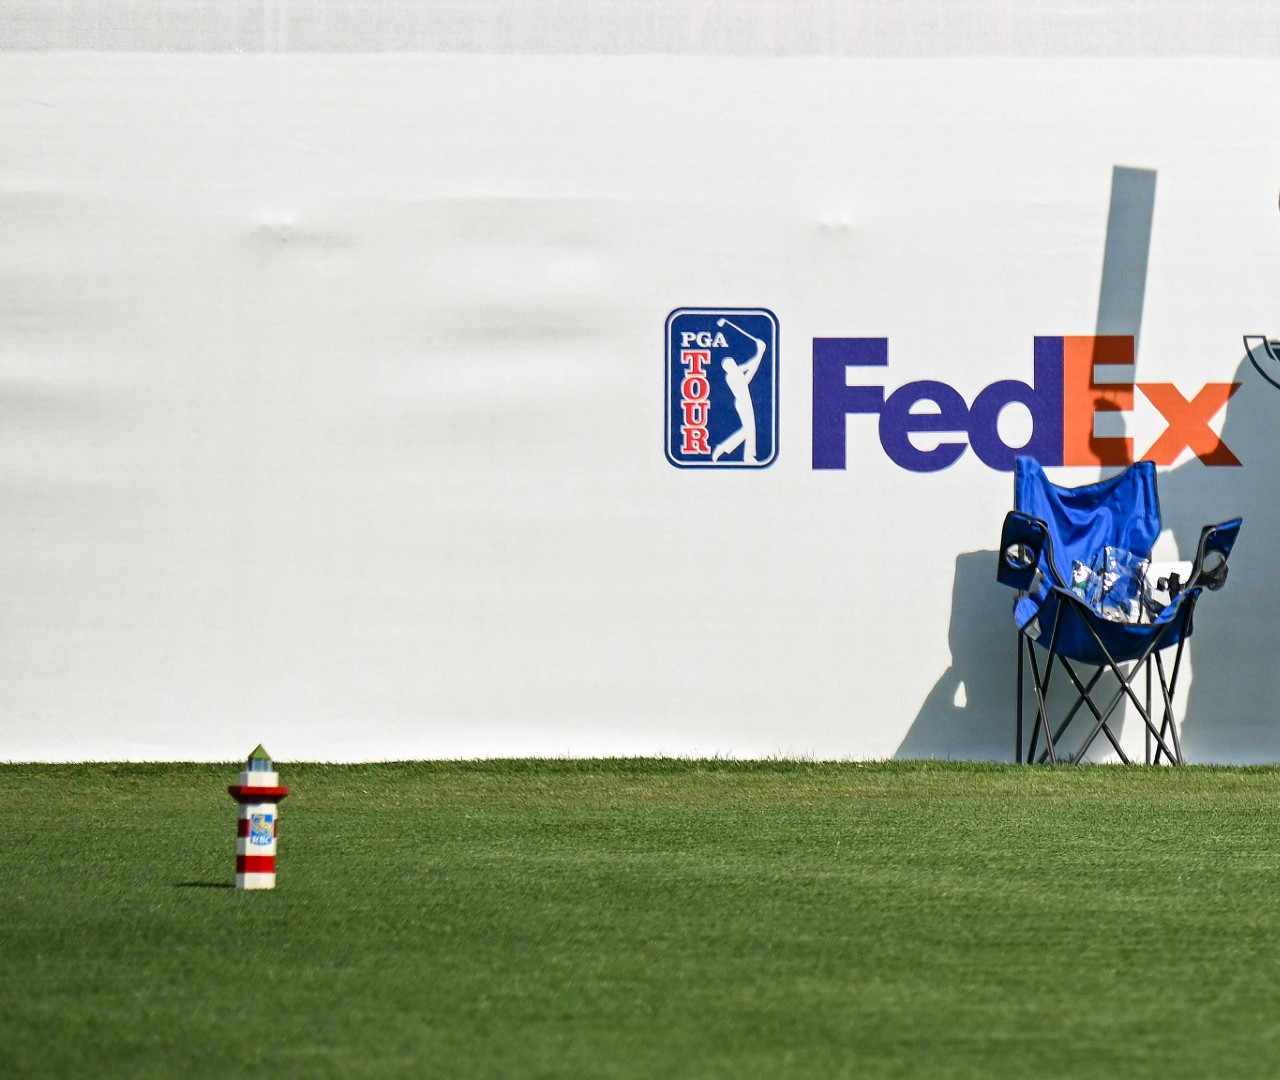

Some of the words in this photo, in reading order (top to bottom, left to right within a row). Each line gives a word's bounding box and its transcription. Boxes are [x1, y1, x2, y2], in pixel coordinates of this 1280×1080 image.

[681, 331, 729, 348] PGA
[680, 350, 711, 455] TOUR
[812, 335, 1243, 473] FedEx
[252, 835, 272, 845] RBC
